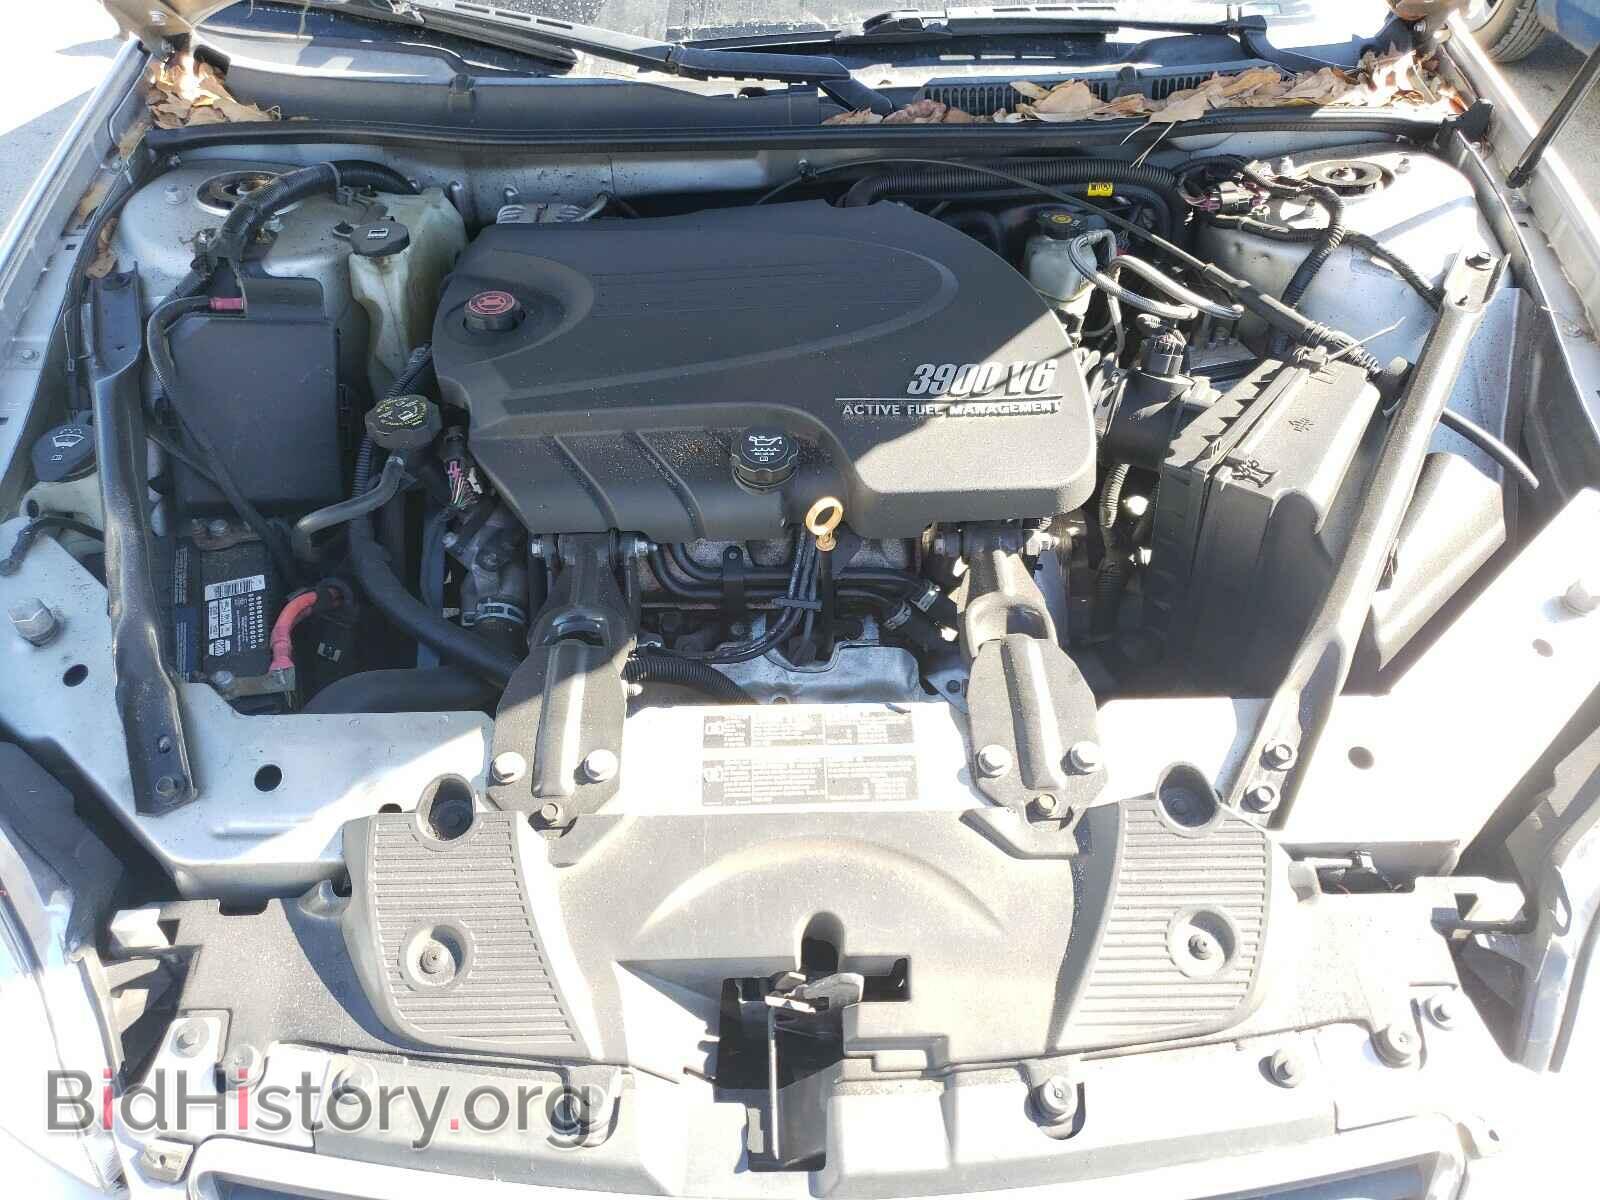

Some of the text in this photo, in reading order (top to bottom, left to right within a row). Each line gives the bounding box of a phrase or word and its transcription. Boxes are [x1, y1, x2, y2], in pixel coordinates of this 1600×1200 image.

[907, 360, 1057, 396] 3900 V6
[842, 401, 1063, 417] ACTIVE FUEL MANAGEMENT
